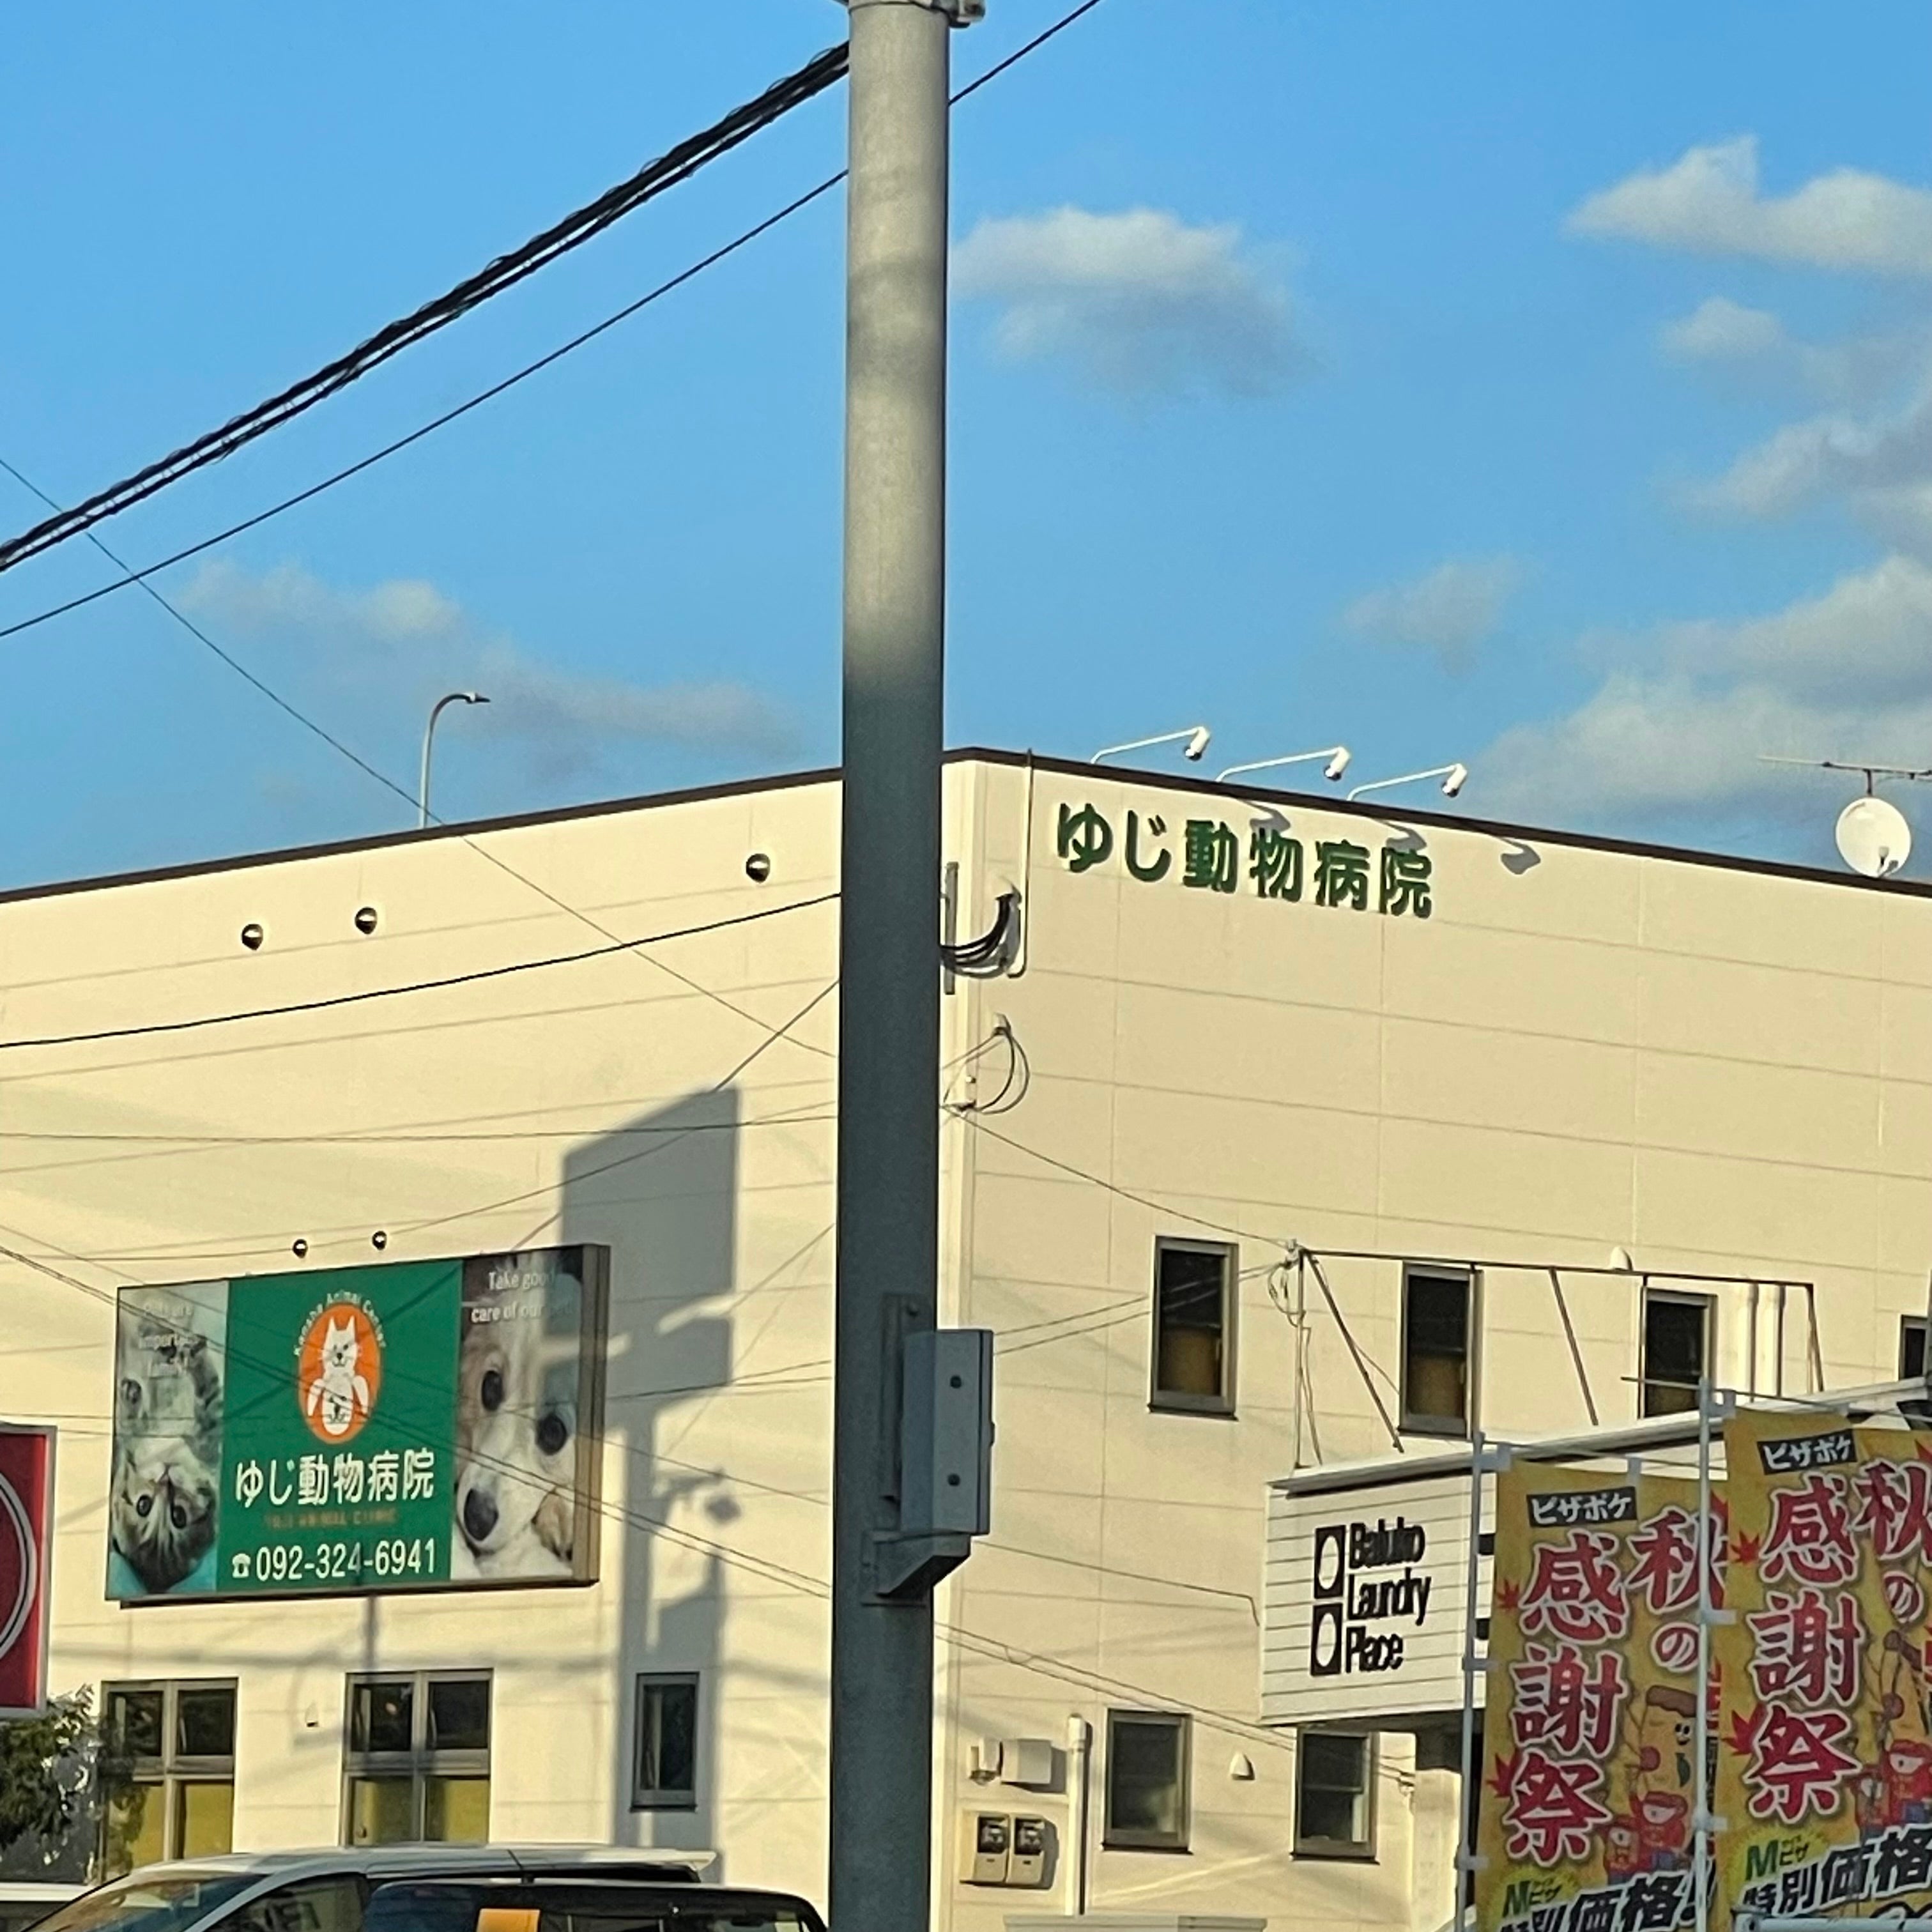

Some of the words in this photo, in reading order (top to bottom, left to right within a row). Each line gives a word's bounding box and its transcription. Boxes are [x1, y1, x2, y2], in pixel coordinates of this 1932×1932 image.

[1057, 802, 1432, 919] ゆじ動物病院
[471, 1307, 502, 1324] care
[489, 1271, 519, 1291] Take
[234, 1447, 435, 1508] ゆじ動物病院
[256, 1537, 436, 1582] 092-324-6941
[1627, 1506, 1727, 1673] 秋の
[1851, 1457, 1932, 1623] 秋の
[1502, 1528, 1630, 1867] 感謝祭
[1744, 1471, 1864, 1823] 感謝祭
